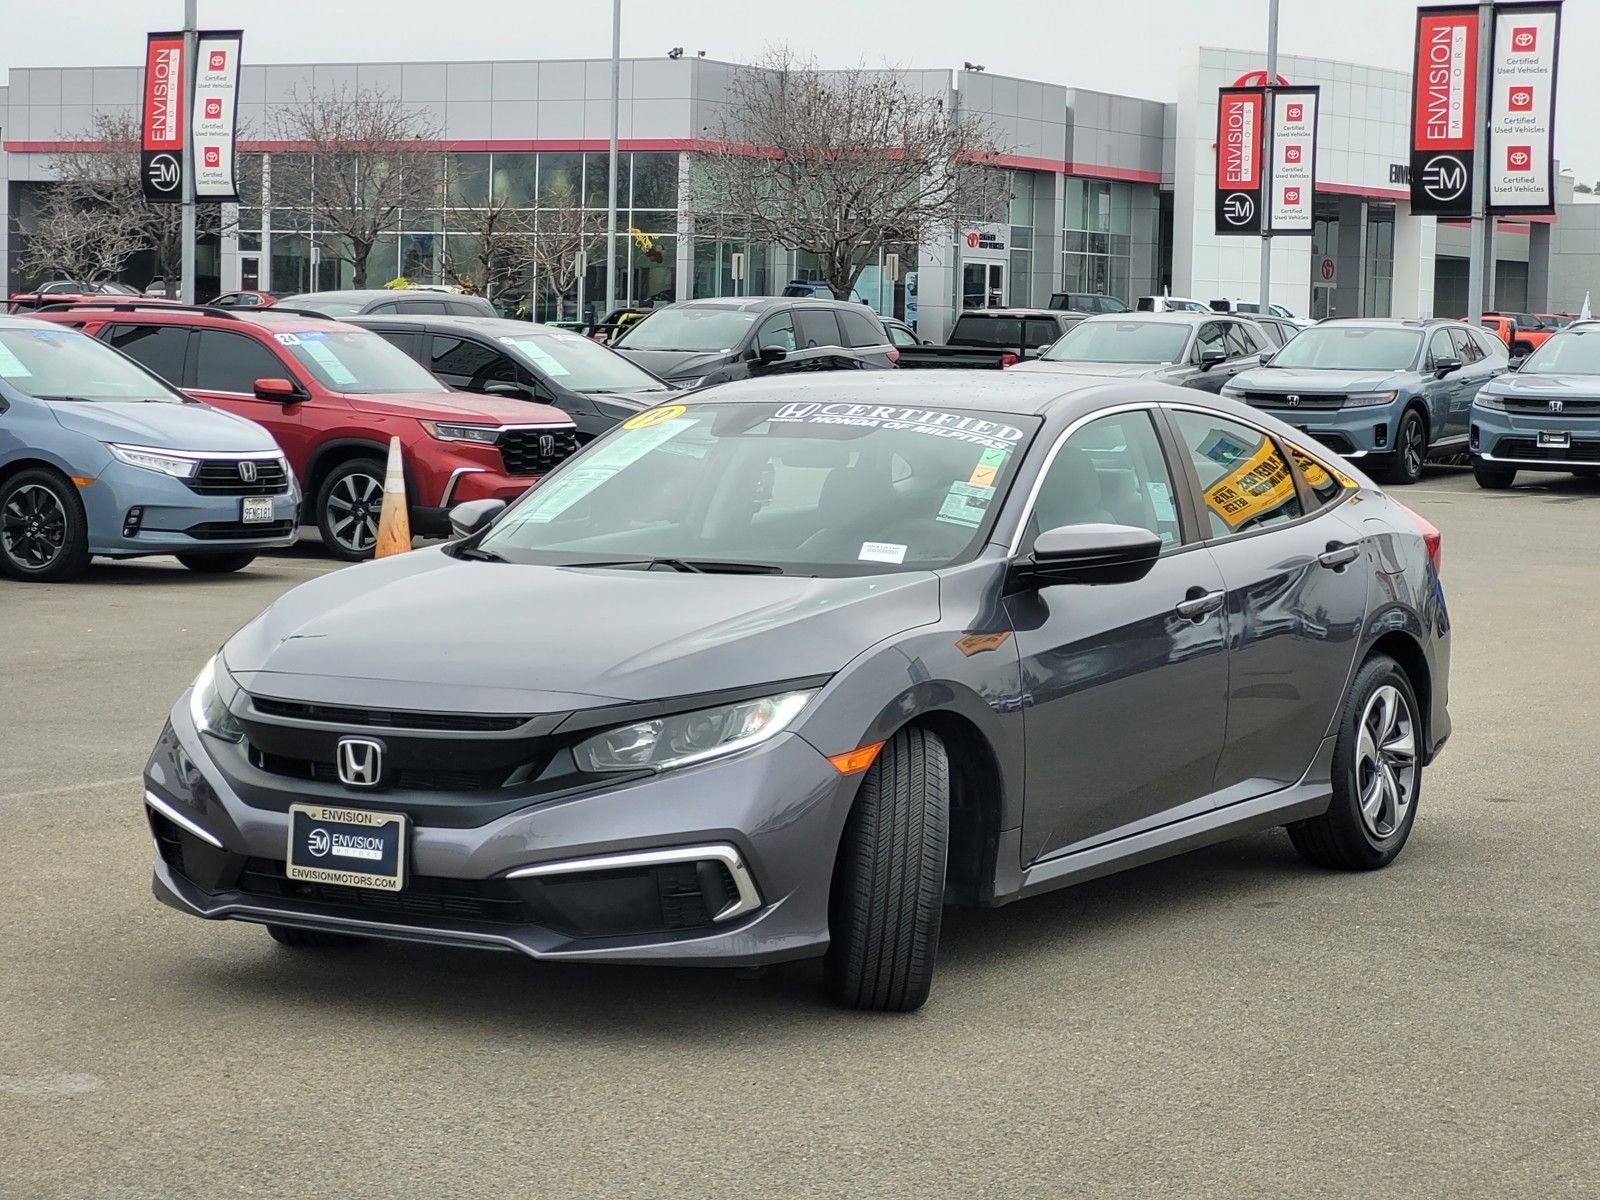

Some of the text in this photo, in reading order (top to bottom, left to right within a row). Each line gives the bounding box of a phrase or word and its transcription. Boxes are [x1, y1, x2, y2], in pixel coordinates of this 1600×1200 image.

[1506, 57, 1540, 65] Certified
[1517, 66, 1549, 74] Vehicles
[1427, 26, 1451, 140] ENVISION
[1452, 36, 1464, 129] MOTORS
[152, 49, 169, 141] ENVISION
[1494, 126, 1545, 134] Used Vehicles
[1227, 102, 1244, 182] ENVISION
[1243, 109, 1251, 175] MOTORS
[1494, 185, 1545, 193] Used Vehicles
[1502, 176, 1536, 184] Certified
[808, 416, 881, 428] HONDA
[881, 422, 914, 430] OF
[910, 424, 1009, 449] MILPITAS
[821, 403, 1024, 441] CERTIFIED
[321, 809, 372, 824] ENVISION
[332, 833, 384, 850] ENVISION
[291, 867, 397, 889] ENVISIONMOTORS.COM
